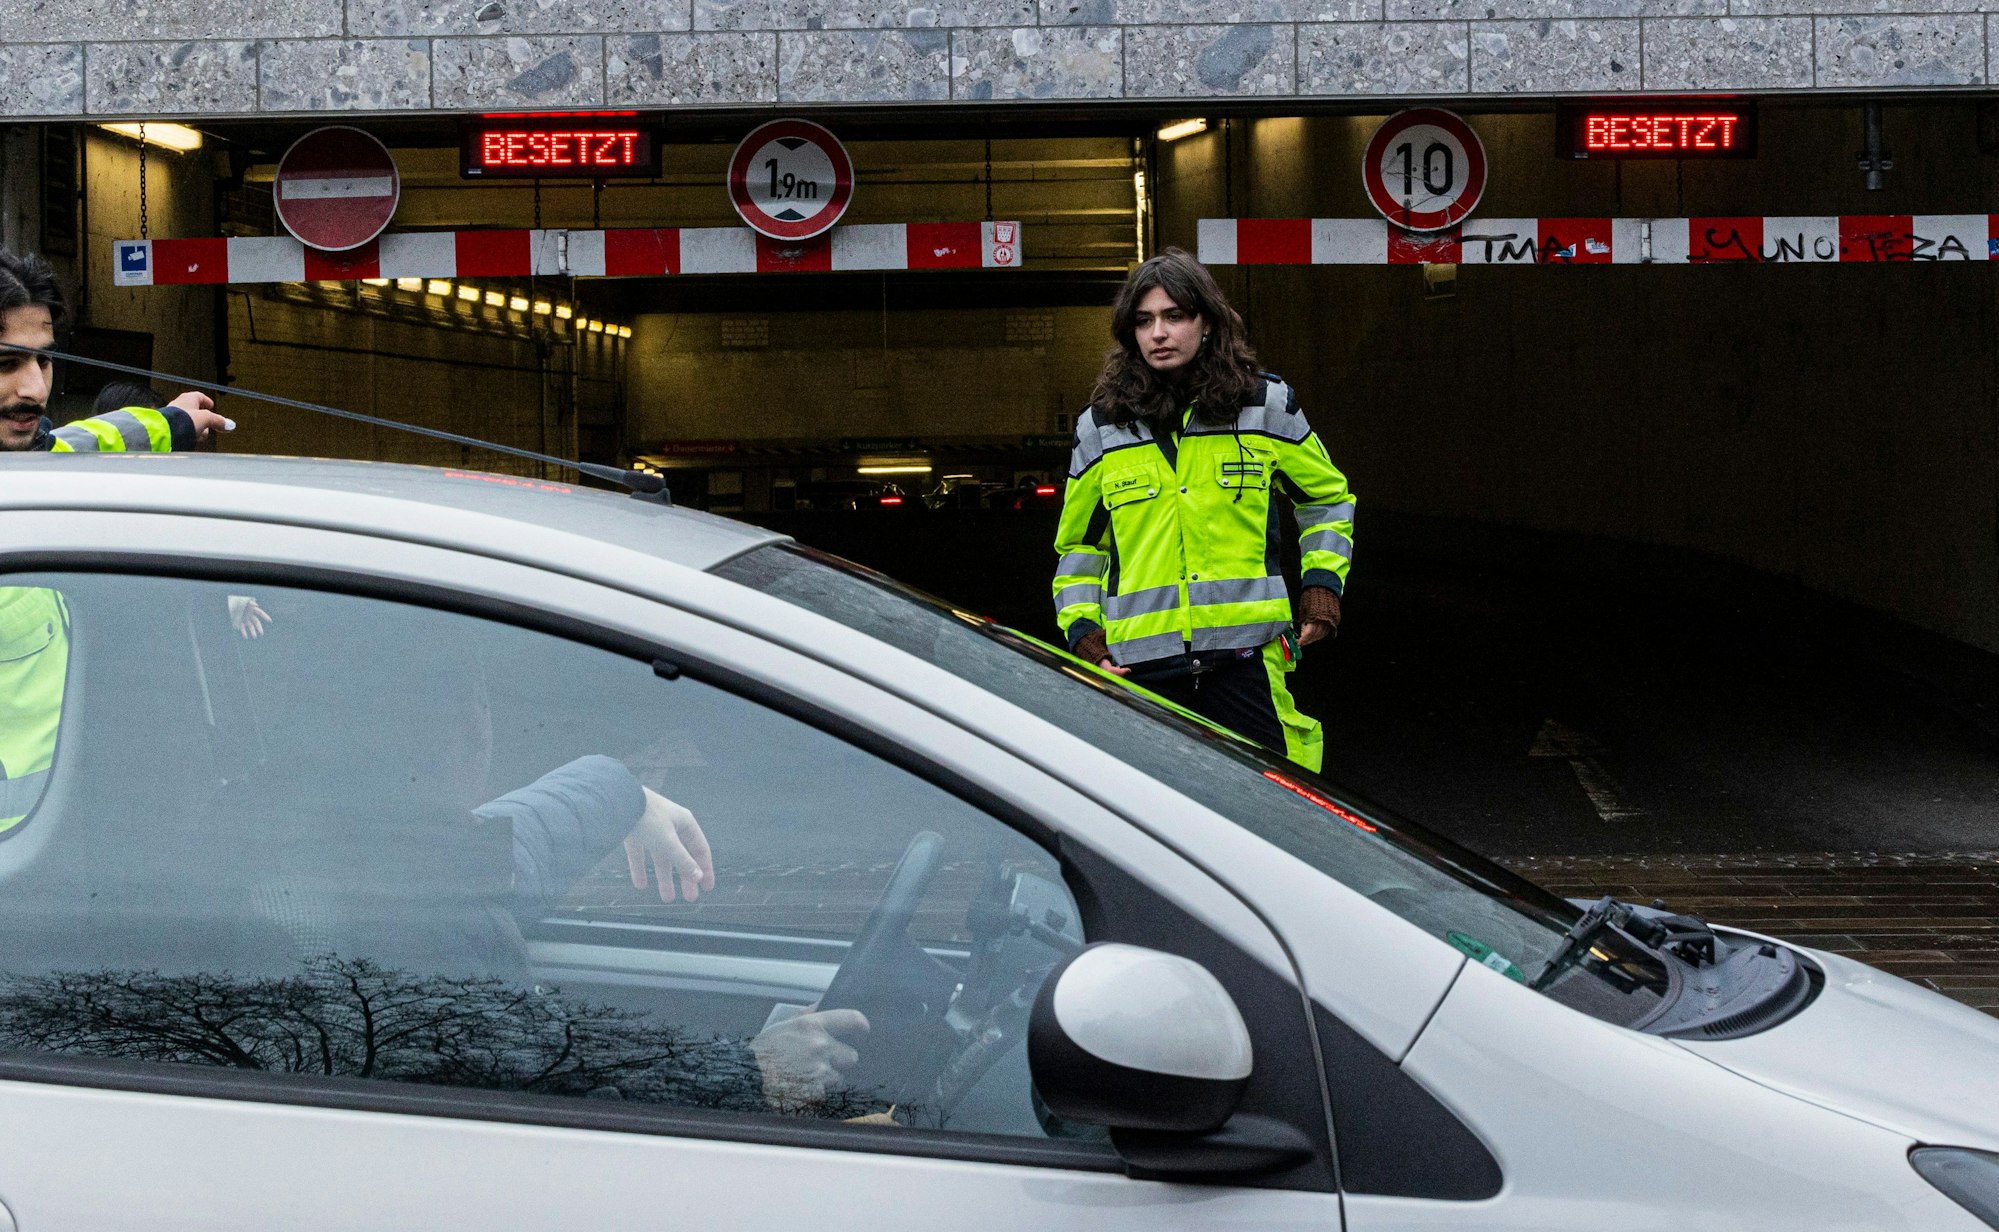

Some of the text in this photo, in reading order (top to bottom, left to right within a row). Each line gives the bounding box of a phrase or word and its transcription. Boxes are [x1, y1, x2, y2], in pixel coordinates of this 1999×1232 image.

[484, 132, 639, 164] BESETZT
[1588, 116, 1738, 149] BESETZT
[1397, 143, 1453, 195] 10
